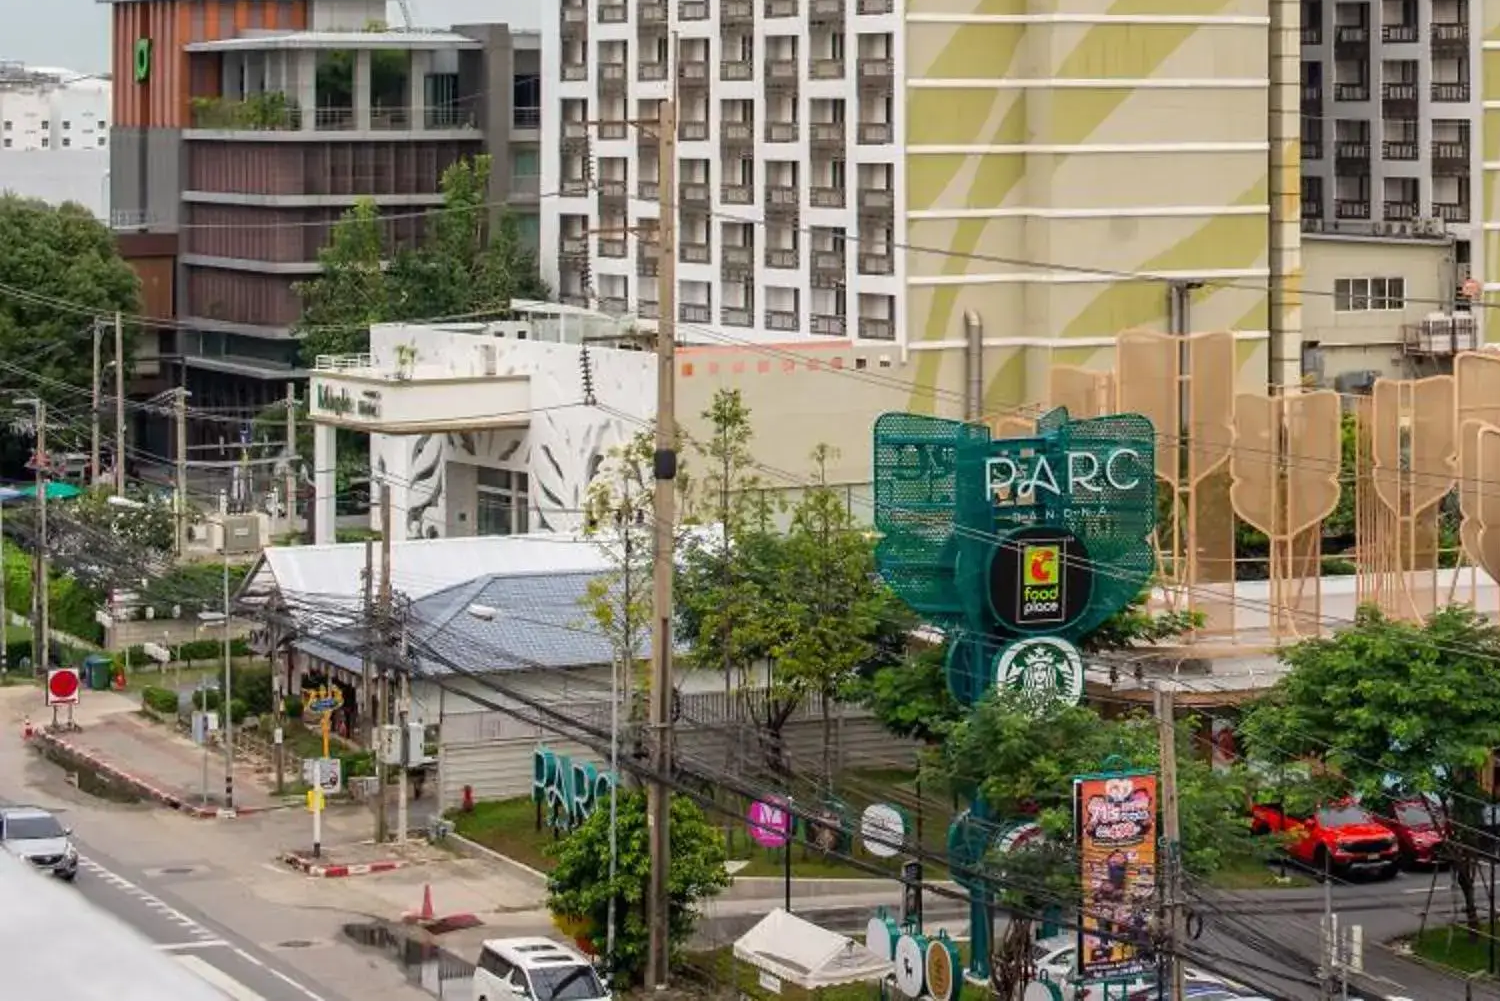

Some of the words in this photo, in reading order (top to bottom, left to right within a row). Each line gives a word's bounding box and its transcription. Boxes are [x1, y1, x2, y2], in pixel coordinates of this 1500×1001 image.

[984, 448, 1140, 501] PARC
[1023, 587, 1059, 601] food
[1023, 599, 1059, 616] place
